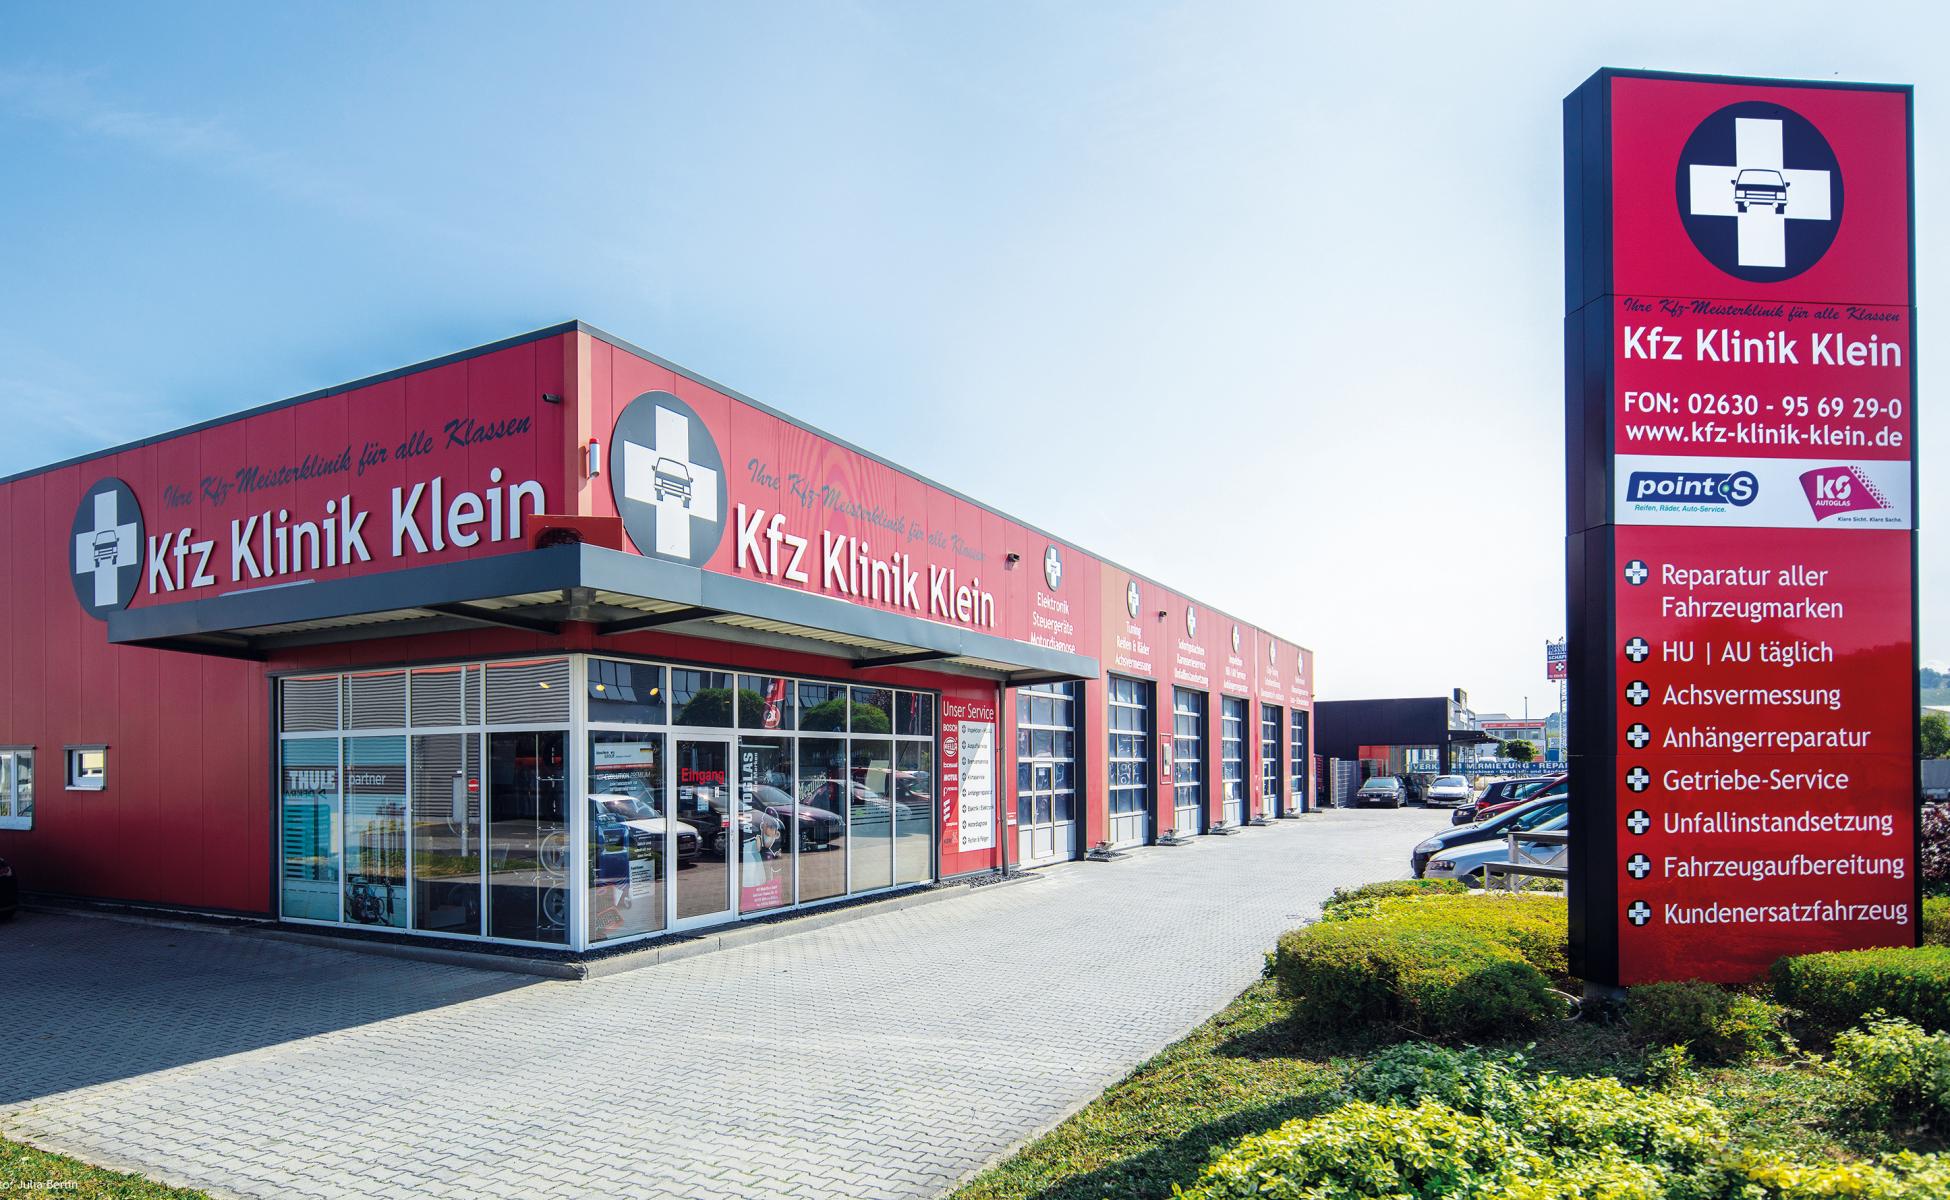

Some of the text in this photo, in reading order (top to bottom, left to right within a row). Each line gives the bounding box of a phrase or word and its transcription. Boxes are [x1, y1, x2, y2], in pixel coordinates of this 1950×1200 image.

[1624, 298, 1900, 322] Ihre Kfz-Meisterklinik für alle Klassen
[1624, 326, 1902, 367] Kfz Klinik Klein
[1624, 391, 1679, 413] FON:
[1688, 393, 1759, 415] 02630
[1782, 396, 1809, 417] 95
[1817, 397, 1844, 418] 69
[1853, 398, 1902, 419] 29-0
[1626, 421, 1903, 447] www.kfz-klinik-klein.de
[164, 413, 532, 512] Ihre Kfz-Meisterklinik für alle Klassen
[747, 458, 780, 490] Ihre
[1634, 504, 1658, 513] Reifen,
[1682, 505, 1727, 514] Auto-Service.
[1815, 499, 1851, 507] AUTOGLAS
[149, 467, 546, 594] Kfz Klinik Klein
[736, 503, 996, 628] Kfz Klinik Klein
[1662, 564, 1828, 590] Reparatur aller
[1037, 591, 1070, 615] Elektronik
[1662, 596, 1843, 622] Fahrzeugmarken
[1032, 611, 1074, 635] Steuergeräte
[1663, 641, 1694, 662] HU
[1721, 641, 1751, 662] AU
[1759, 641, 1834, 667] täglich
[1662, 684, 1841, 710] Achsvermessung
[943, 700, 994, 720] Unser Service
[943, 723, 958, 733] BOSCH
[1663, 726, 1871, 752] Anhängerreparatur
[681, 767, 724, 785] Eingang
[1538, 761, 1567, 770] REPA
[289, 770, 386, 790] THULE partner
[1663, 769, 1849, 791] Getriebe-Service
[1664, 811, 1893, 836] Unfallinstandsetzung
[1664, 854, 1905, 881] Fahrzeugaufbereitung
[1665, 900, 1908, 925] Kundenersatzfahrzeug
